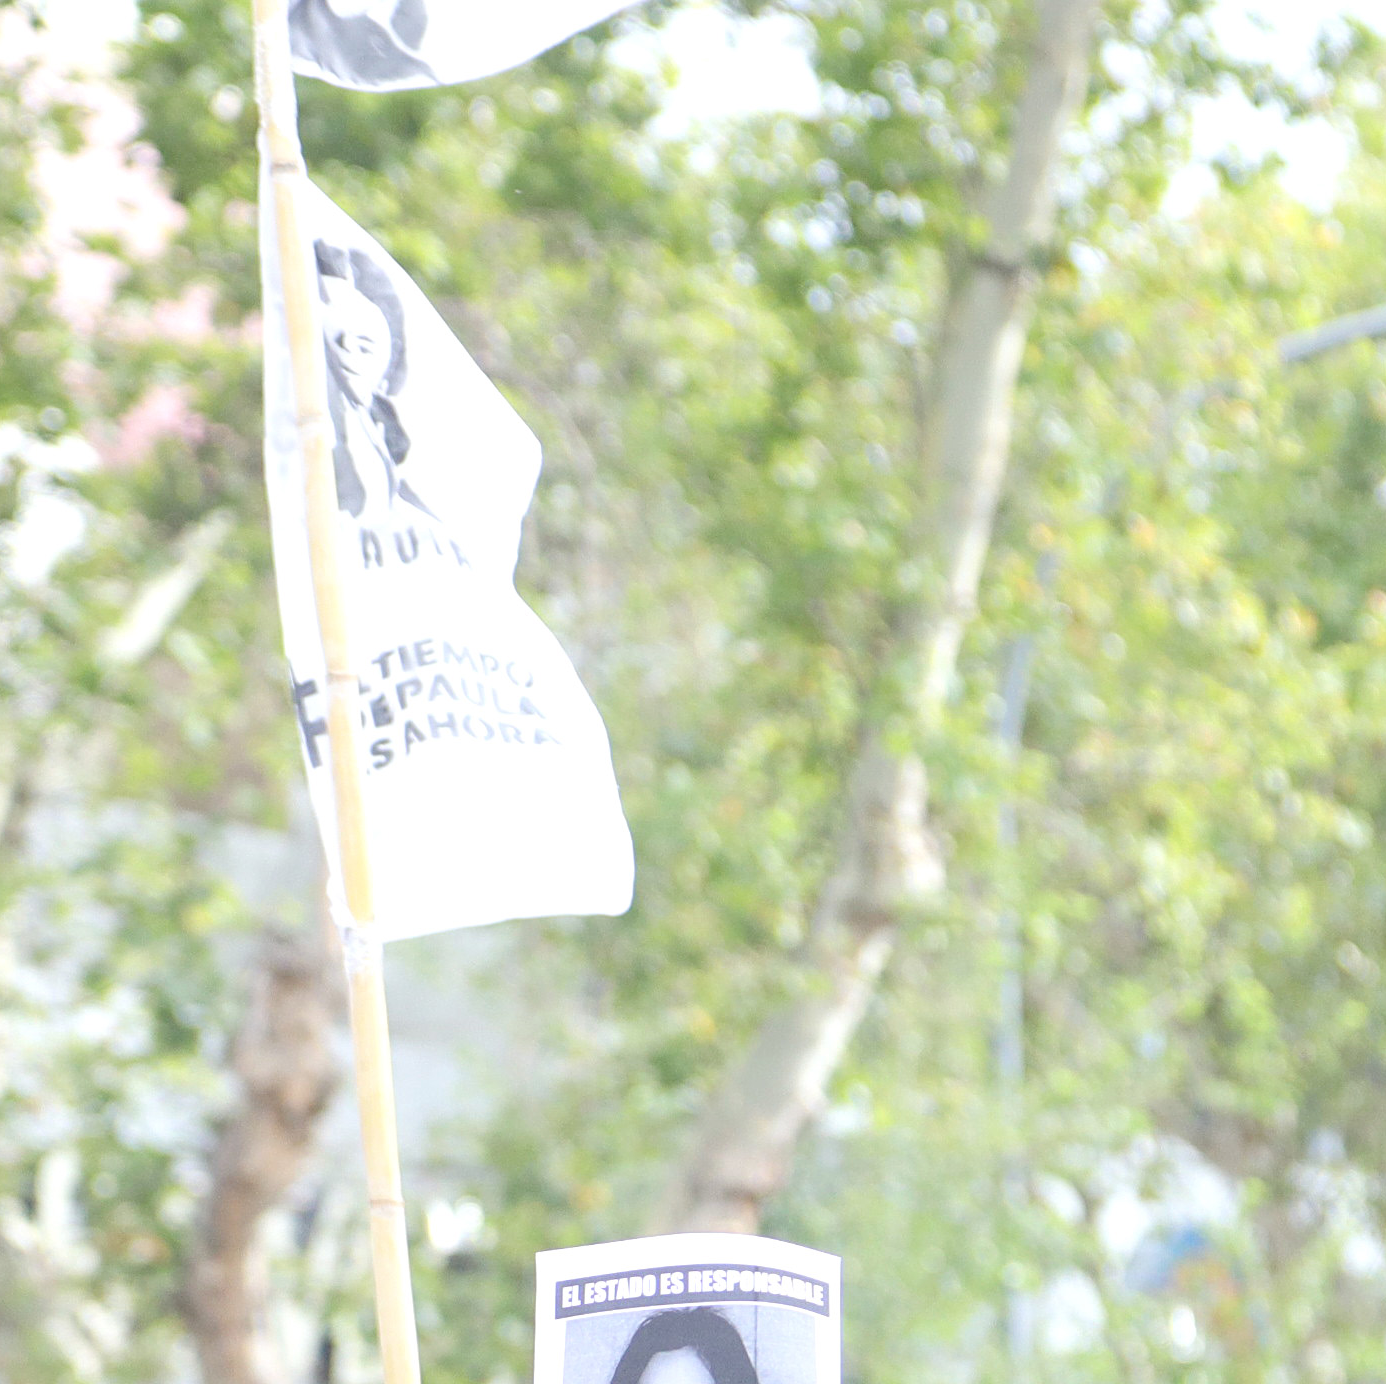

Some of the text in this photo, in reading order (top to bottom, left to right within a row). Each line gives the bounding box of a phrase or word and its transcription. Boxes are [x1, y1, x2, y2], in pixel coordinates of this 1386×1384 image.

[561, 1269, 825, 1309] EL ESTADO ES RESPONSABLE
